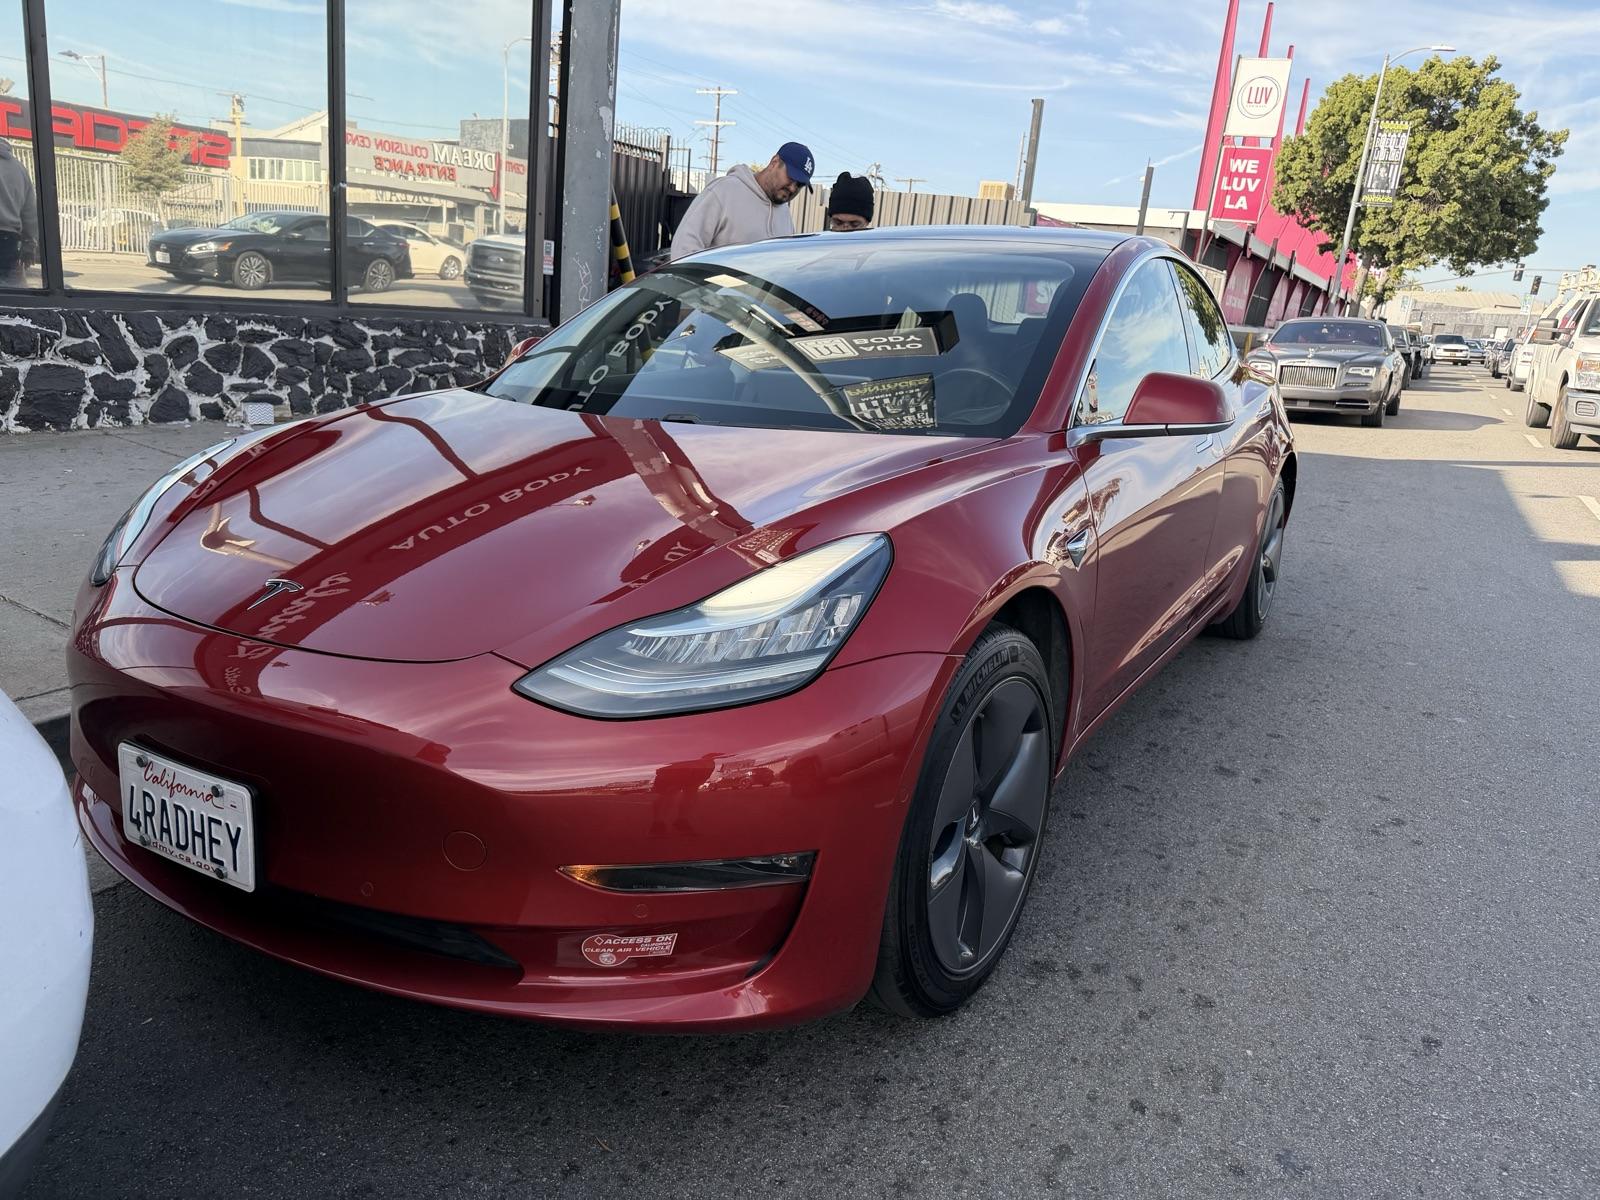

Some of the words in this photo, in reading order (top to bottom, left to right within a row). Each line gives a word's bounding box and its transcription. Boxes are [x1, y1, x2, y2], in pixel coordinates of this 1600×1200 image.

[1247, 86, 1273, 104] LUV
[804, 156, 812, 174] LA
[1229, 158, 1259, 174] WE
[1221, 176, 1261, 192] LUV
[1224, 195, 1248, 210] LA
[964, 648, 1009, 702] MICHELIN
[143, 760, 225, 810] California
[129, 783, 242, 873] 4RADHEY
[603, 936, 652, 945] ACCESS
[655, 935, 673, 943] OK
[635, 945, 670, 953] VEHICLE
